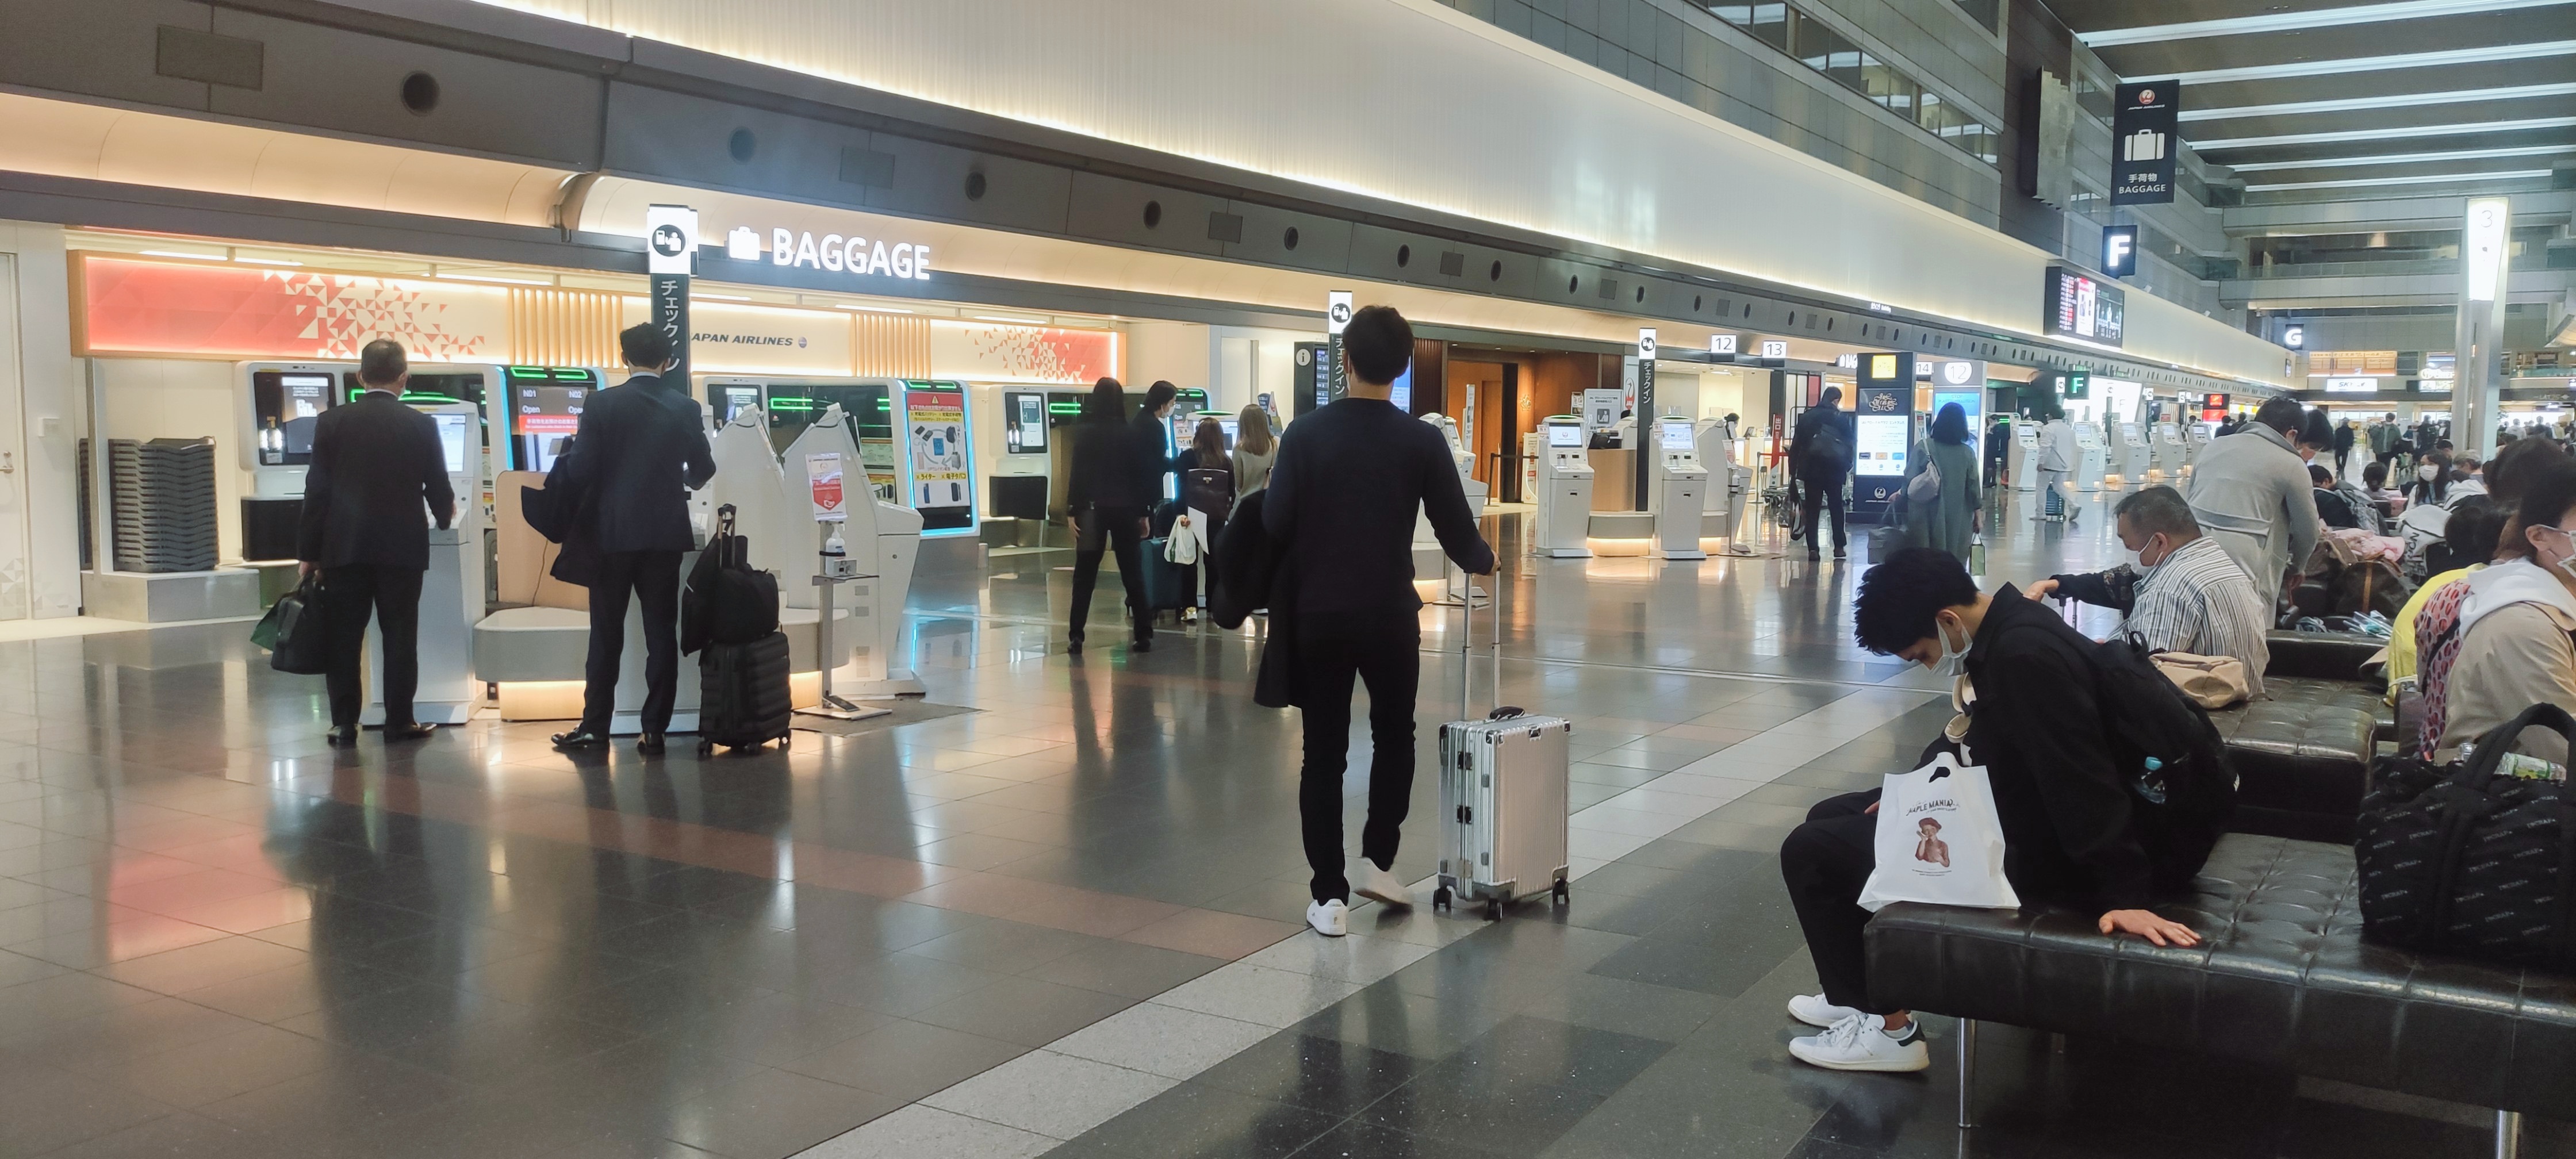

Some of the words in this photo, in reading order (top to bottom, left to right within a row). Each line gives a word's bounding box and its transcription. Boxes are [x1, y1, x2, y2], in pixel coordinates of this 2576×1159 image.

[2128, 172, 2157, 183] 手荷物
[2118, 184, 2166, 194] BAGGAGE
[2481, 210, 2493, 228] 3
[772, 227, 930, 281] BAGGAGE
[2109, 235, 2131, 267] F
[691, 332, 729, 343] APAN
[732, 335, 793, 346] AIRLINES
[1716, 337, 1732, 350] 12
[2285, 329, 2302, 346] G
[1767, 344, 1782, 355] 13
[1917, 363, 1929, 373] 14
[1950, 365, 1966, 379] 12
[1643, 362, 1651, 404] チェックイン
[2072, 377, 2084, 393] F
[522, 405, 541, 414] Open
[1774, 417, 1781, 431] 出口
[1929, 799, 1954, 808] MANIA
